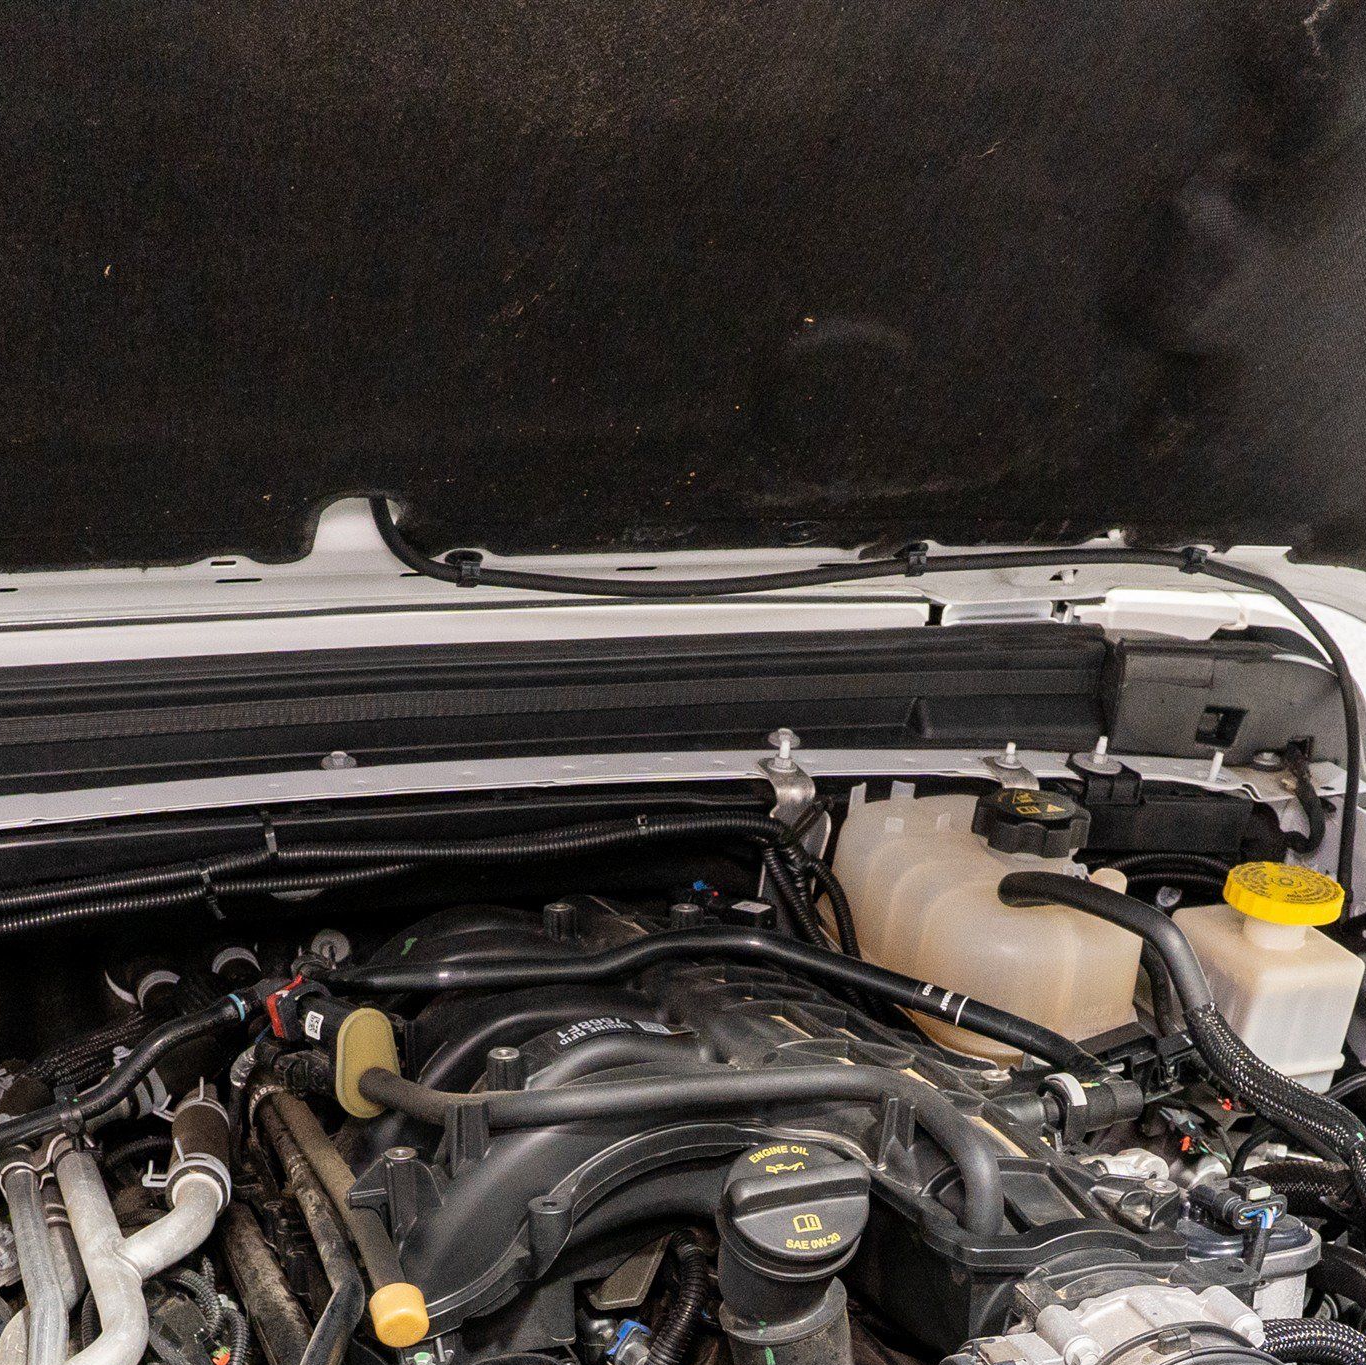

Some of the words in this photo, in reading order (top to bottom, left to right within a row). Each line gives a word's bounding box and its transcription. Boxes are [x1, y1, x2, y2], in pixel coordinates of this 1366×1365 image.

[589, 1021, 633, 1034] ENGINE
[559, 1030, 587, 1046] RFID
[748, 1145, 788, 1164] ENGINE
[791, 1145, 810, 1156] OIL
[786, 1238, 810, 1250] SAE
[810, 1232, 841, 1250] 0W-20
